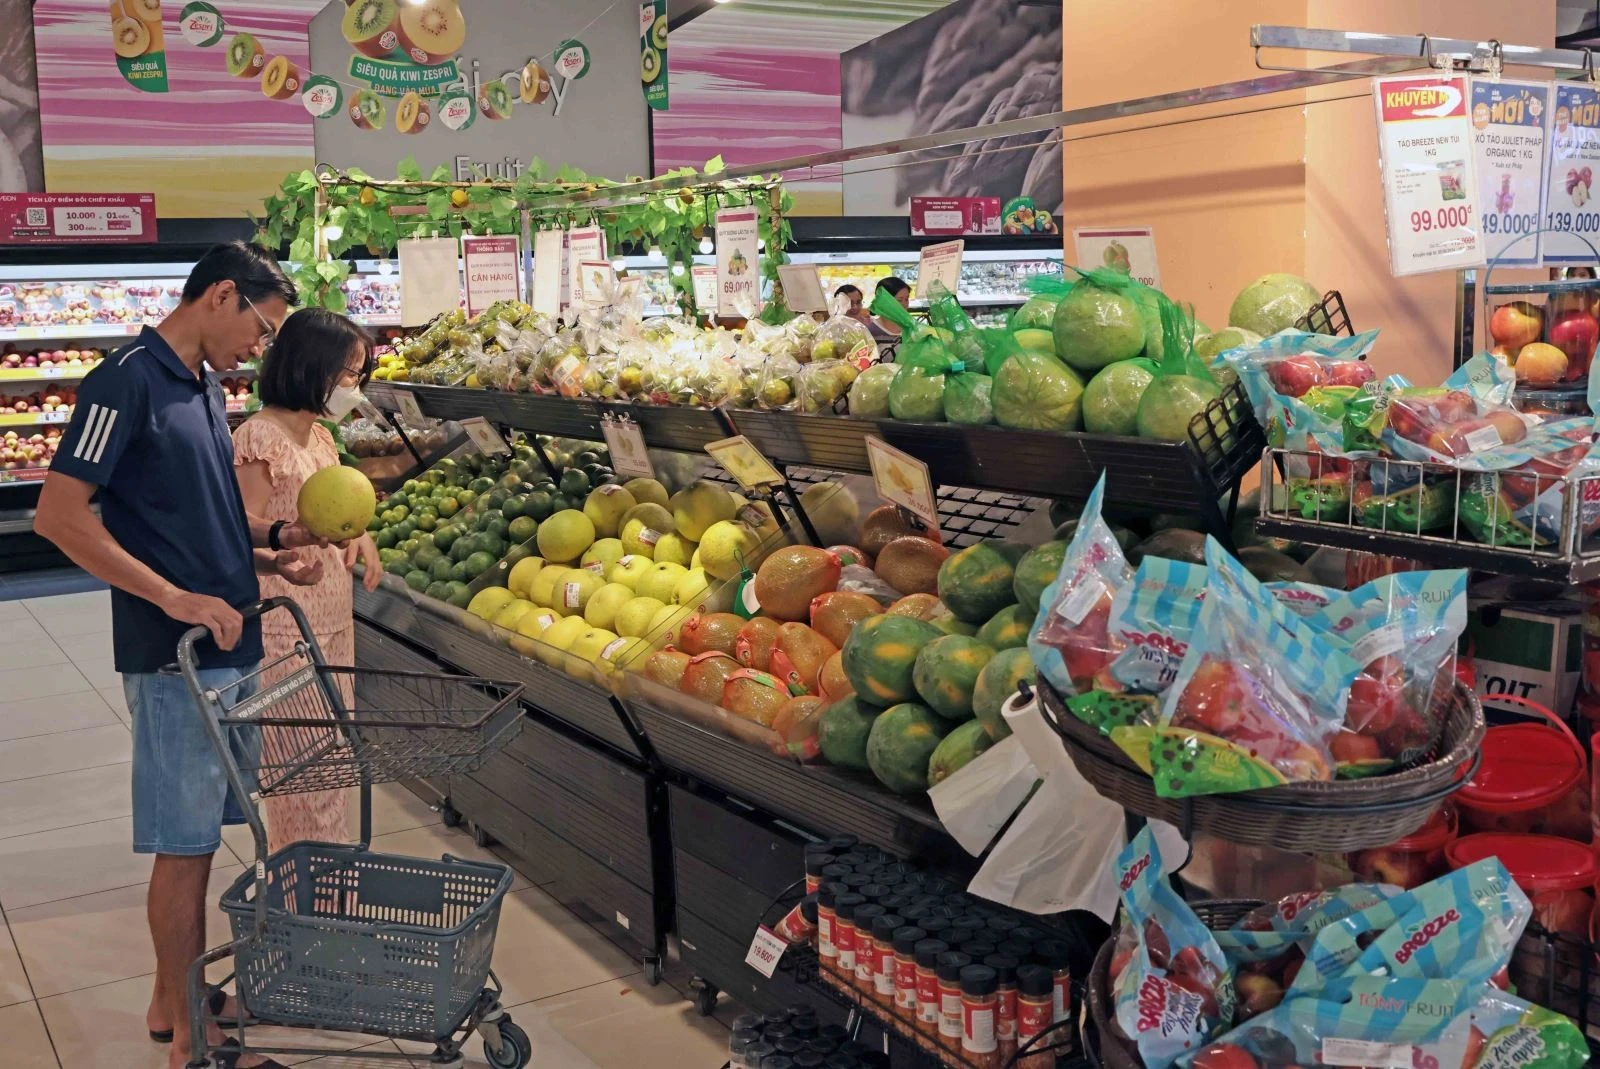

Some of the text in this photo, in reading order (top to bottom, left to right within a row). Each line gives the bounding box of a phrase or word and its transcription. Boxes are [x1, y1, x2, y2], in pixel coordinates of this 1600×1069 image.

[356, 62, 453, 81] SIÊU QUẢ KIWI ZESPRI
[1411, 138, 1435, 147] BREEZE
[1436, 137, 1449, 145] NEW
[1501, 135, 1524, 146] JULIET
[1425, 149, 1437, 157] 1KG
[1486, 147, 1517, 159] ORGANIC
[1523, 149, 1533, 159] KG
[456, 156, 525, 182] Fruit
[106, 211, 117, 219] 01
[68, 223, 84, 231] 300
[287, 678, 299, 691] VÀO
[1406, 1002, 1455, 1018] FRUIT
